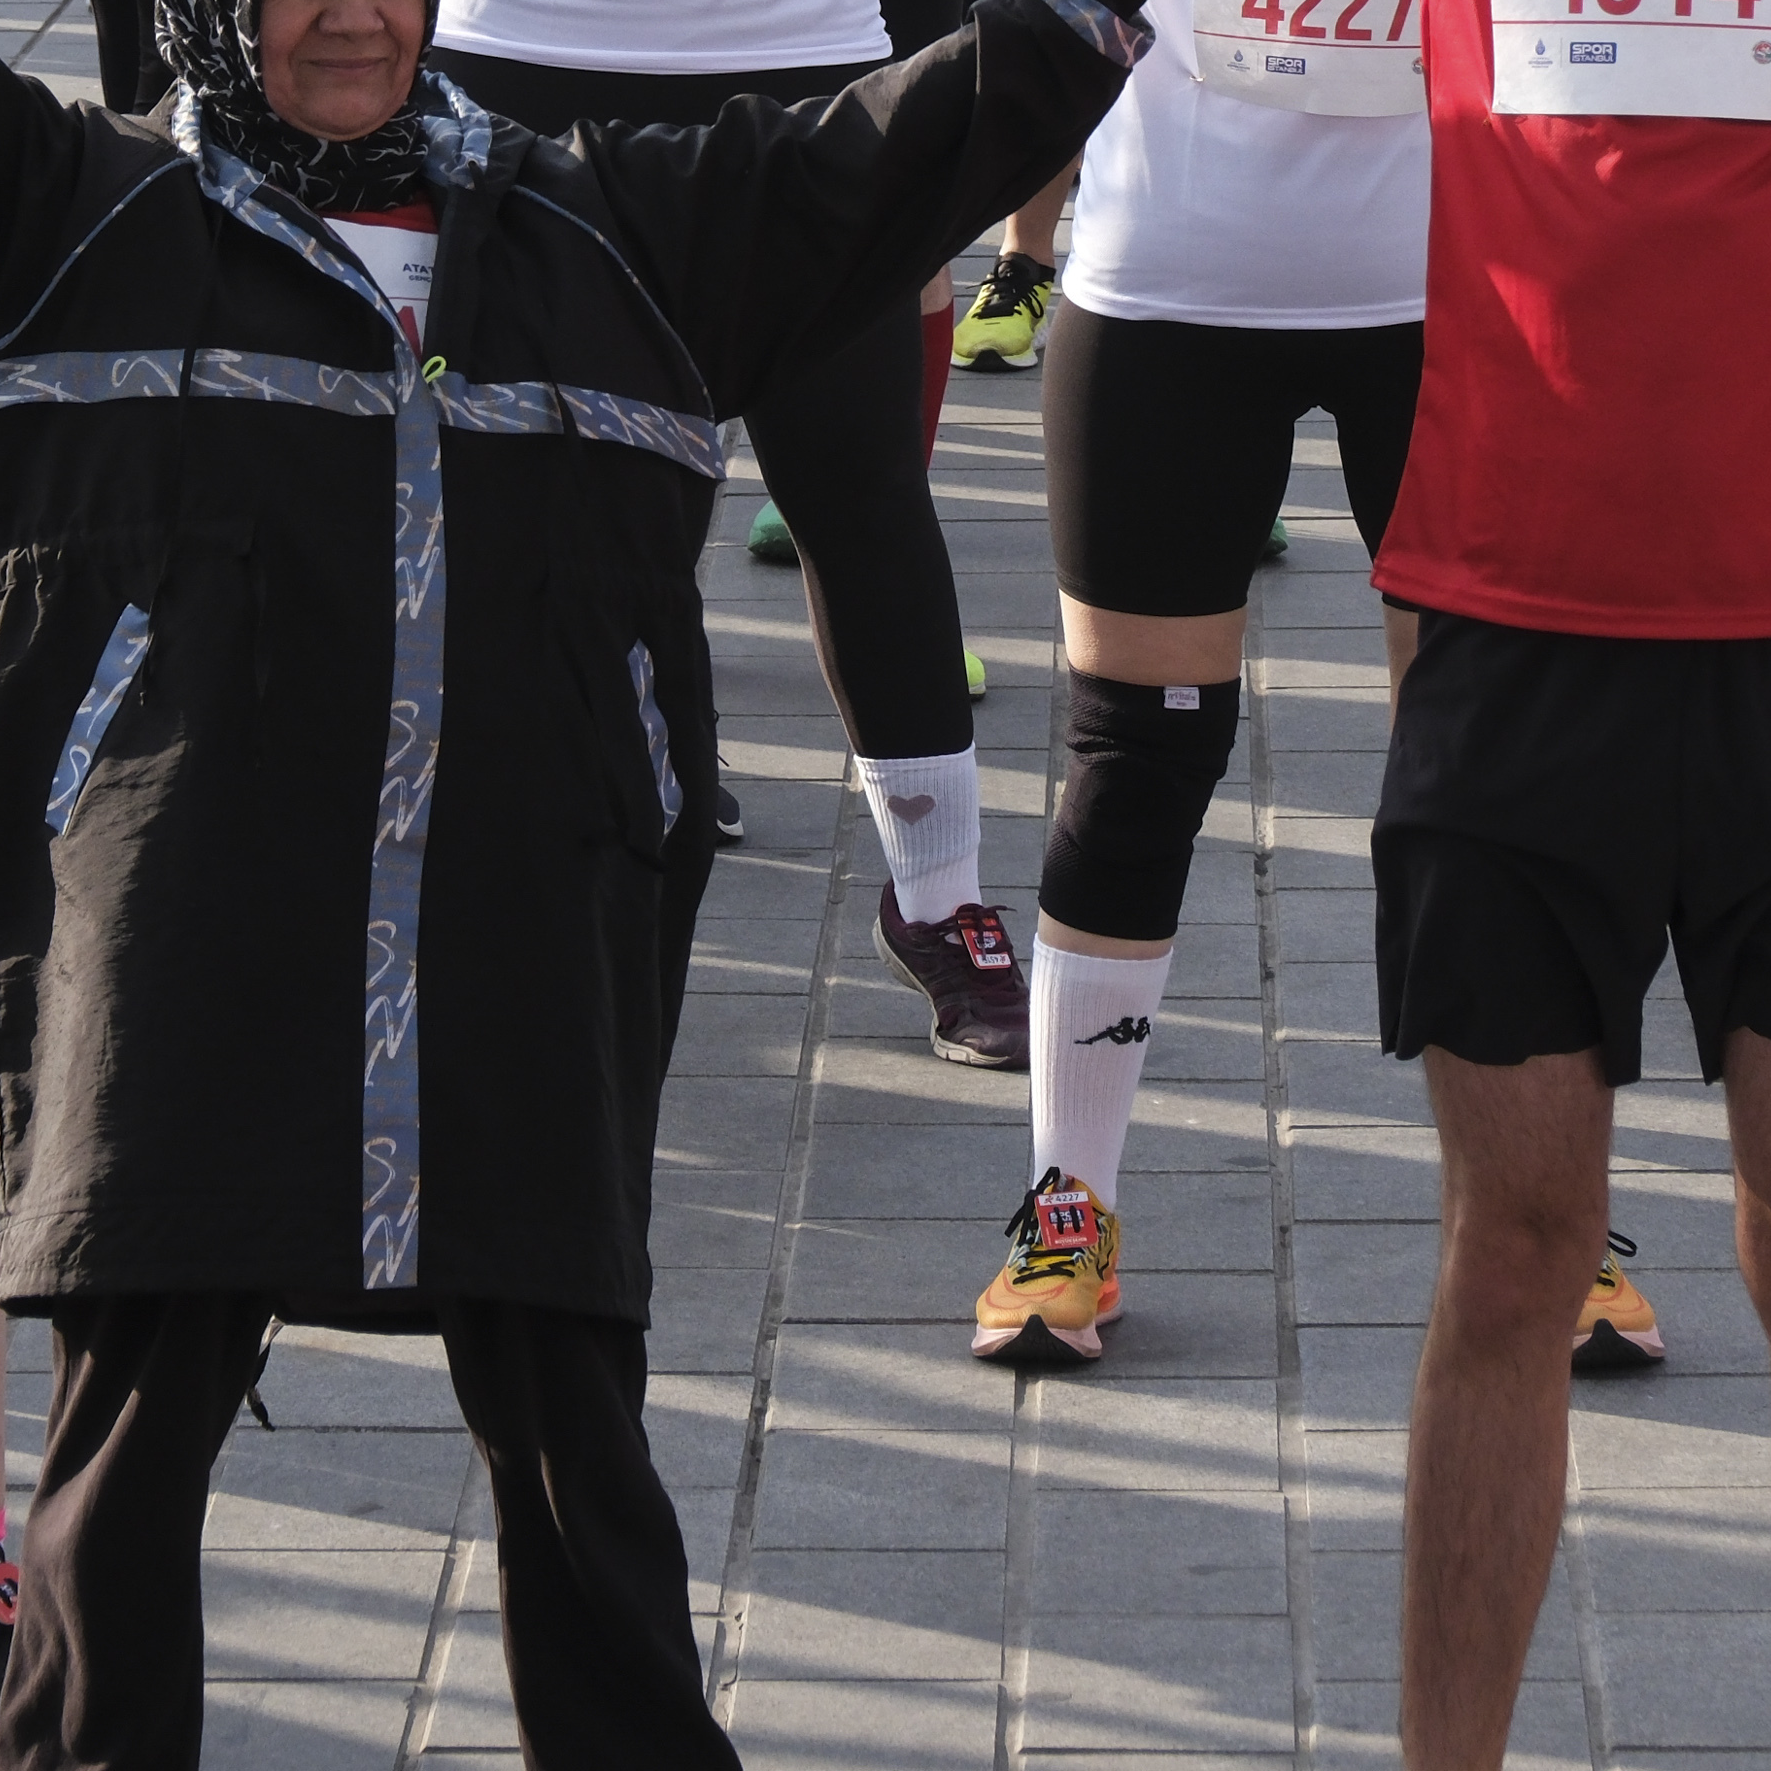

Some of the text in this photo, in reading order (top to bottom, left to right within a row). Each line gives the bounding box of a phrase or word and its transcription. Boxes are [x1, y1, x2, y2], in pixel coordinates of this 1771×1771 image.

[1571, 43, 1614, 56] SPOR
[1267, 57, 1303, 69] SPOR
[1055, 1193, 1080, 1202] 4227
